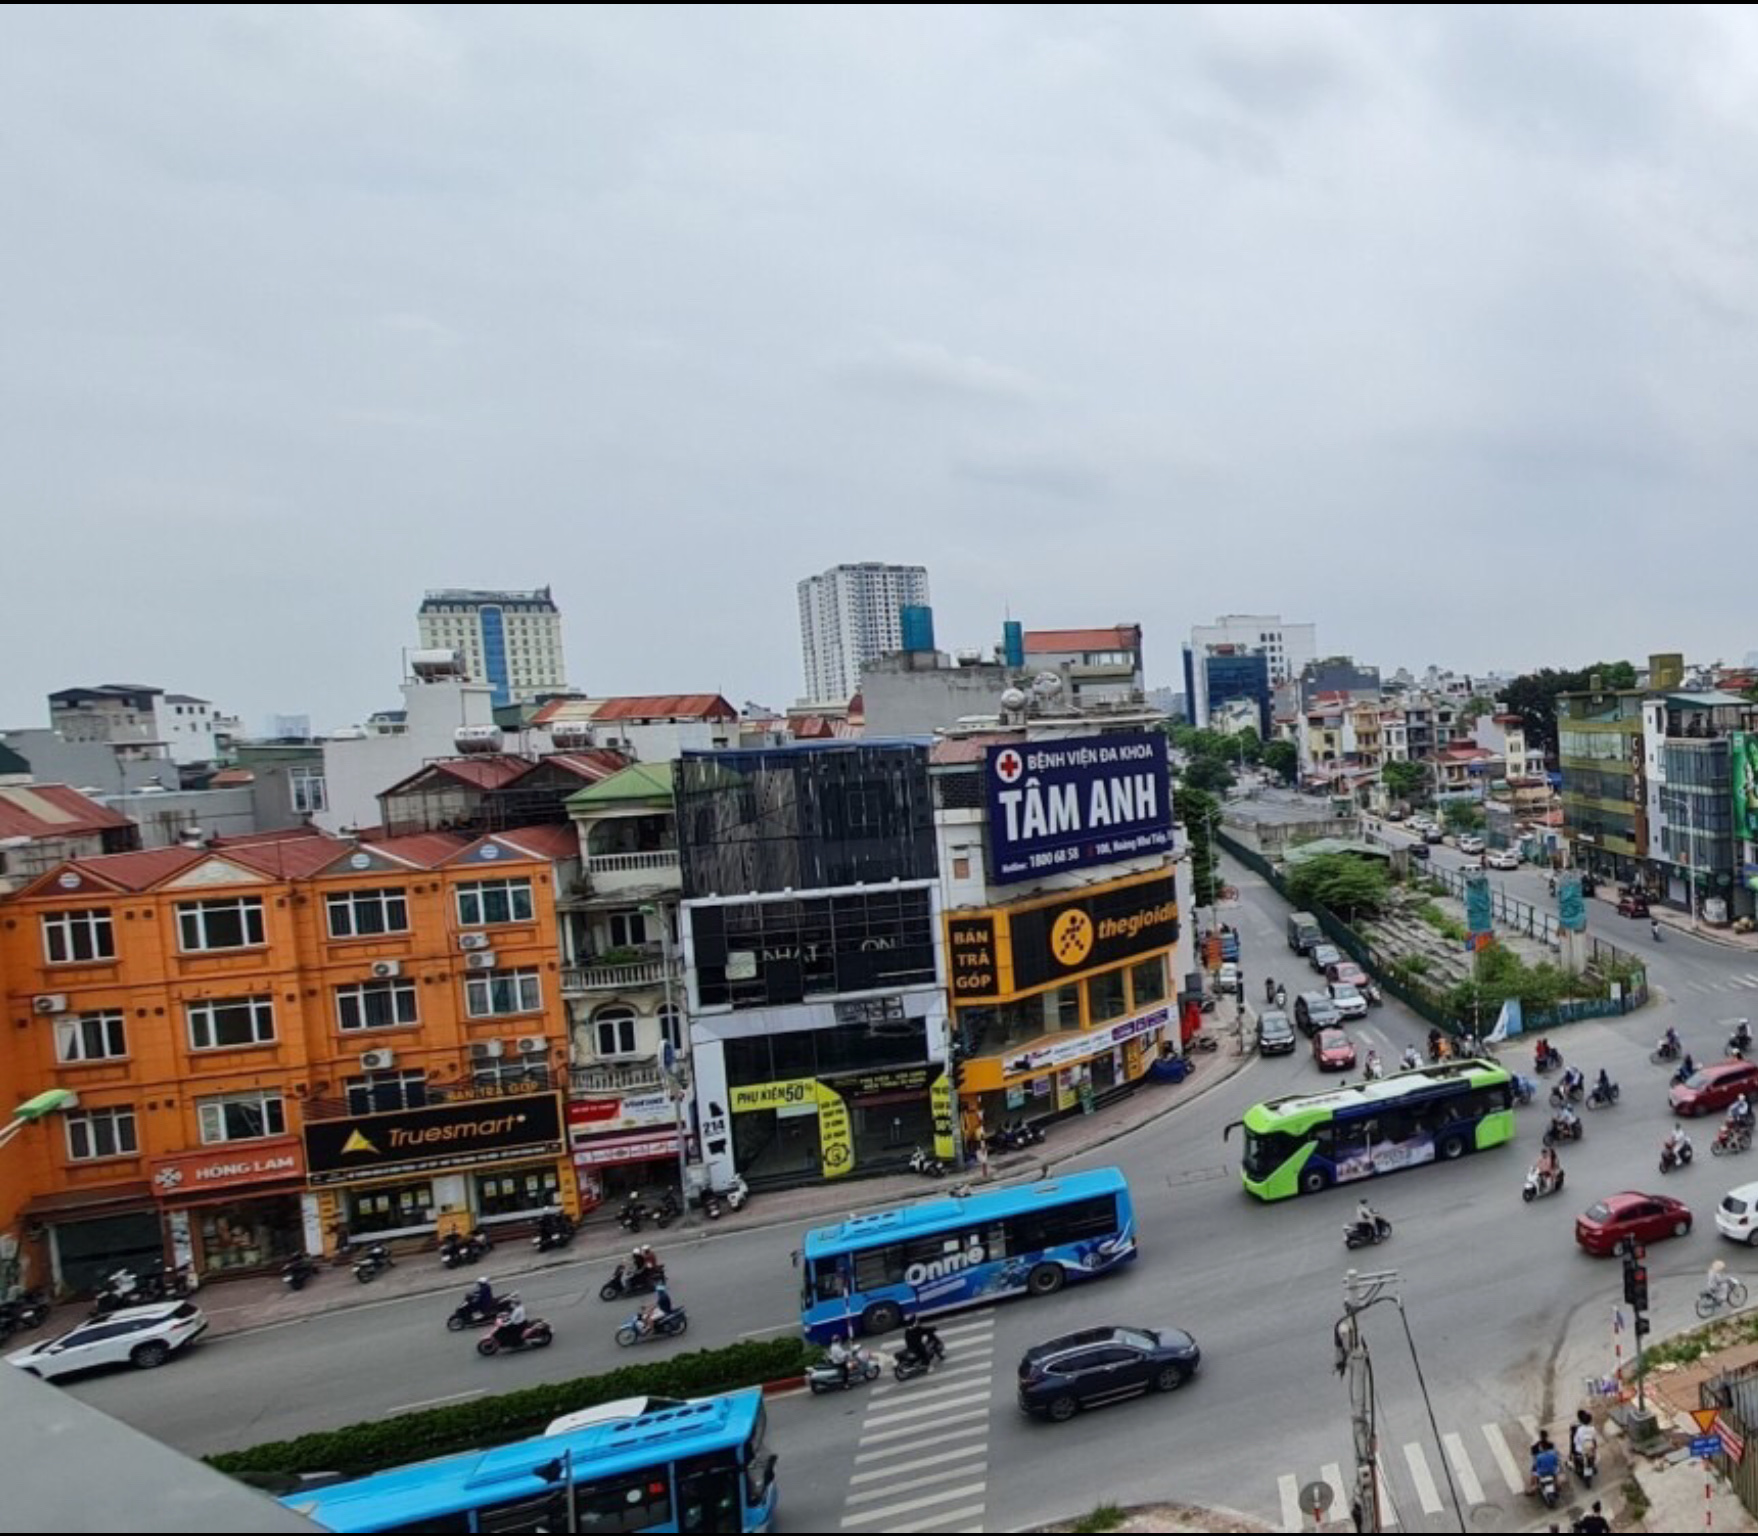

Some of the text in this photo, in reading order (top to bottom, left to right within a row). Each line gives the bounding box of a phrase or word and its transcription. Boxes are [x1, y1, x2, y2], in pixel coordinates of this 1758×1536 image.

[1027, 744, 1153, 773] BỆNH VIỆN ĐA KHOA
[998, 773, 1157, 841] TÂM ANH
[954, 929, 988, 945] BÁN
[956, 948, 990, 967] TRẢ
[956, 971, 992, 989] GÓP
[389, 1114, 516, 1148] Truesmart
[702, 1119, 725, 1137] 214
